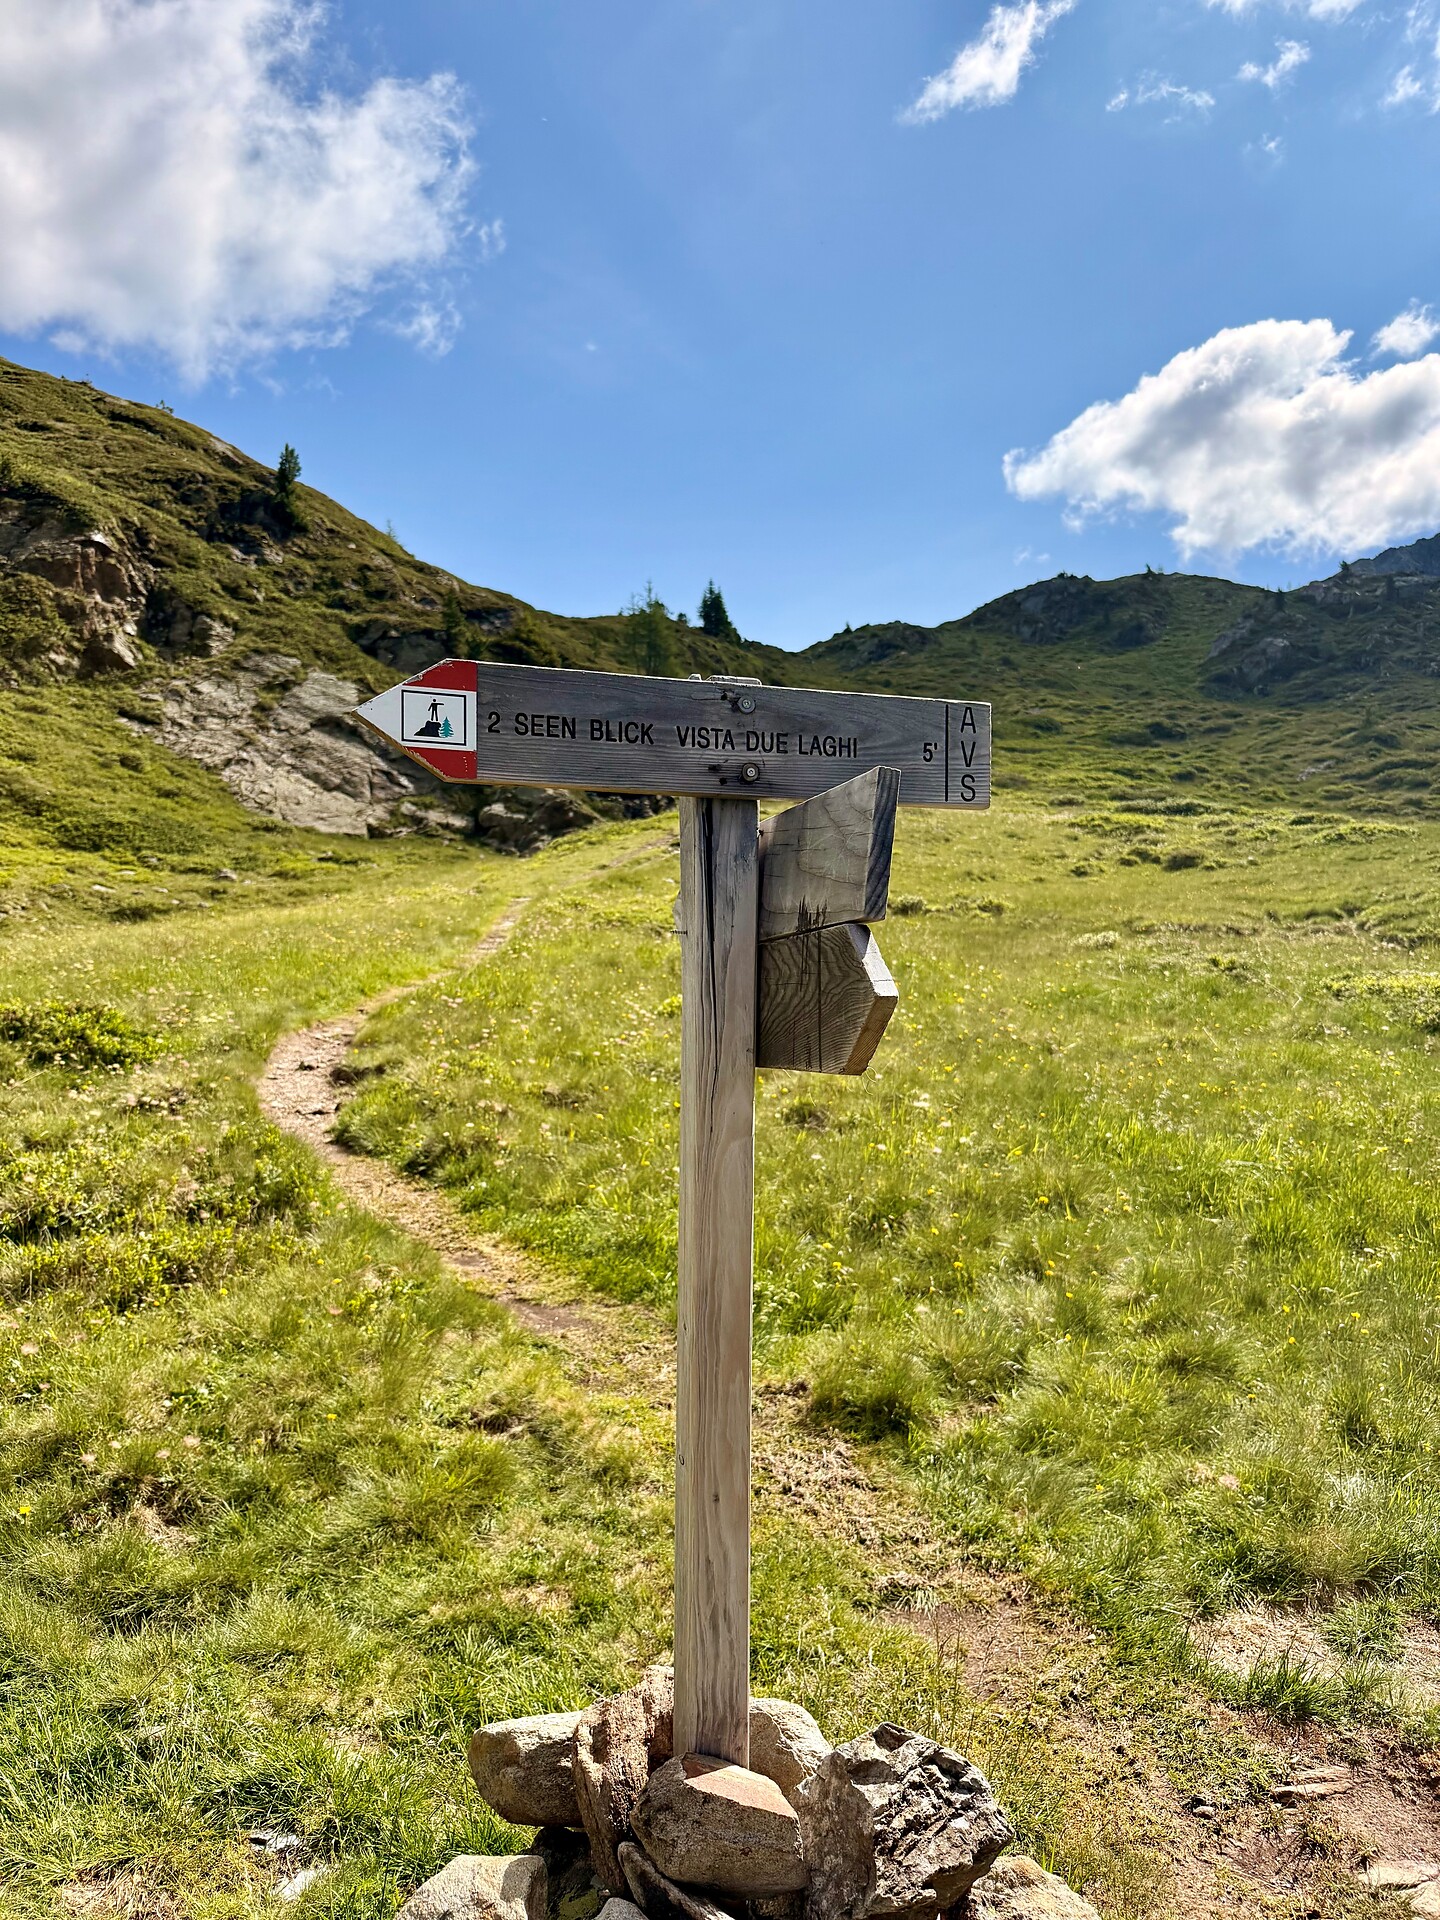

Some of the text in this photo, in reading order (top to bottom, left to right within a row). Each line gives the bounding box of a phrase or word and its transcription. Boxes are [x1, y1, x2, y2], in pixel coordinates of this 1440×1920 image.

[487, 711, 858, 759] 2 SEEN BLICK VISTA DUE LAGHI
[922, 742, 938, 763] 5'
